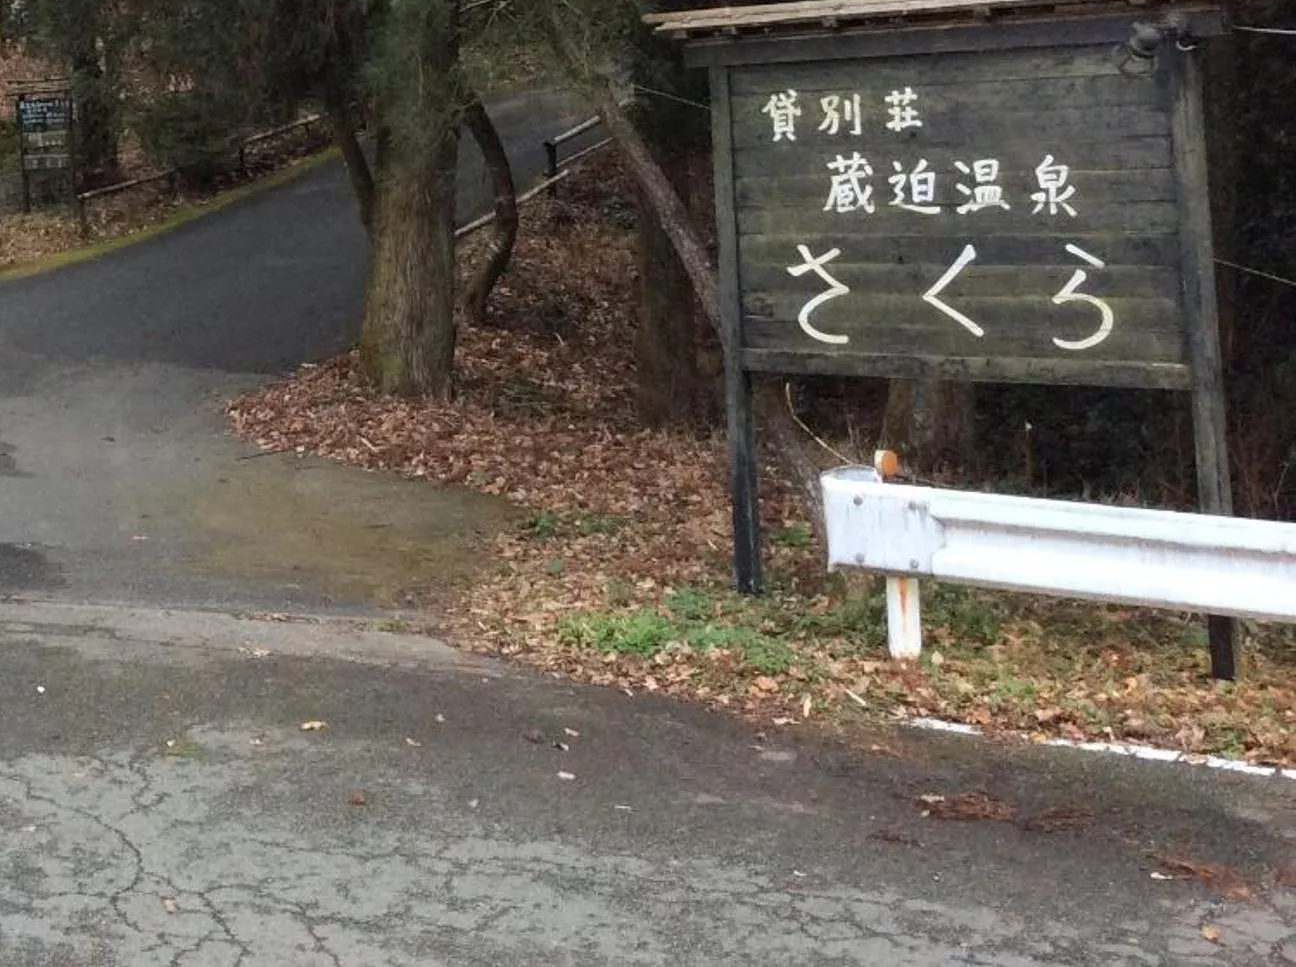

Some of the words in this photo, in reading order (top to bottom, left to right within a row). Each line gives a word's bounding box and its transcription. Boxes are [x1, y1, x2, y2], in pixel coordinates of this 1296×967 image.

[760, 87, 924, 142] 貸別荘
[822, 151, 1078, 218] 蔵迫温泉
[786, 242, 1114, 350] さくら
